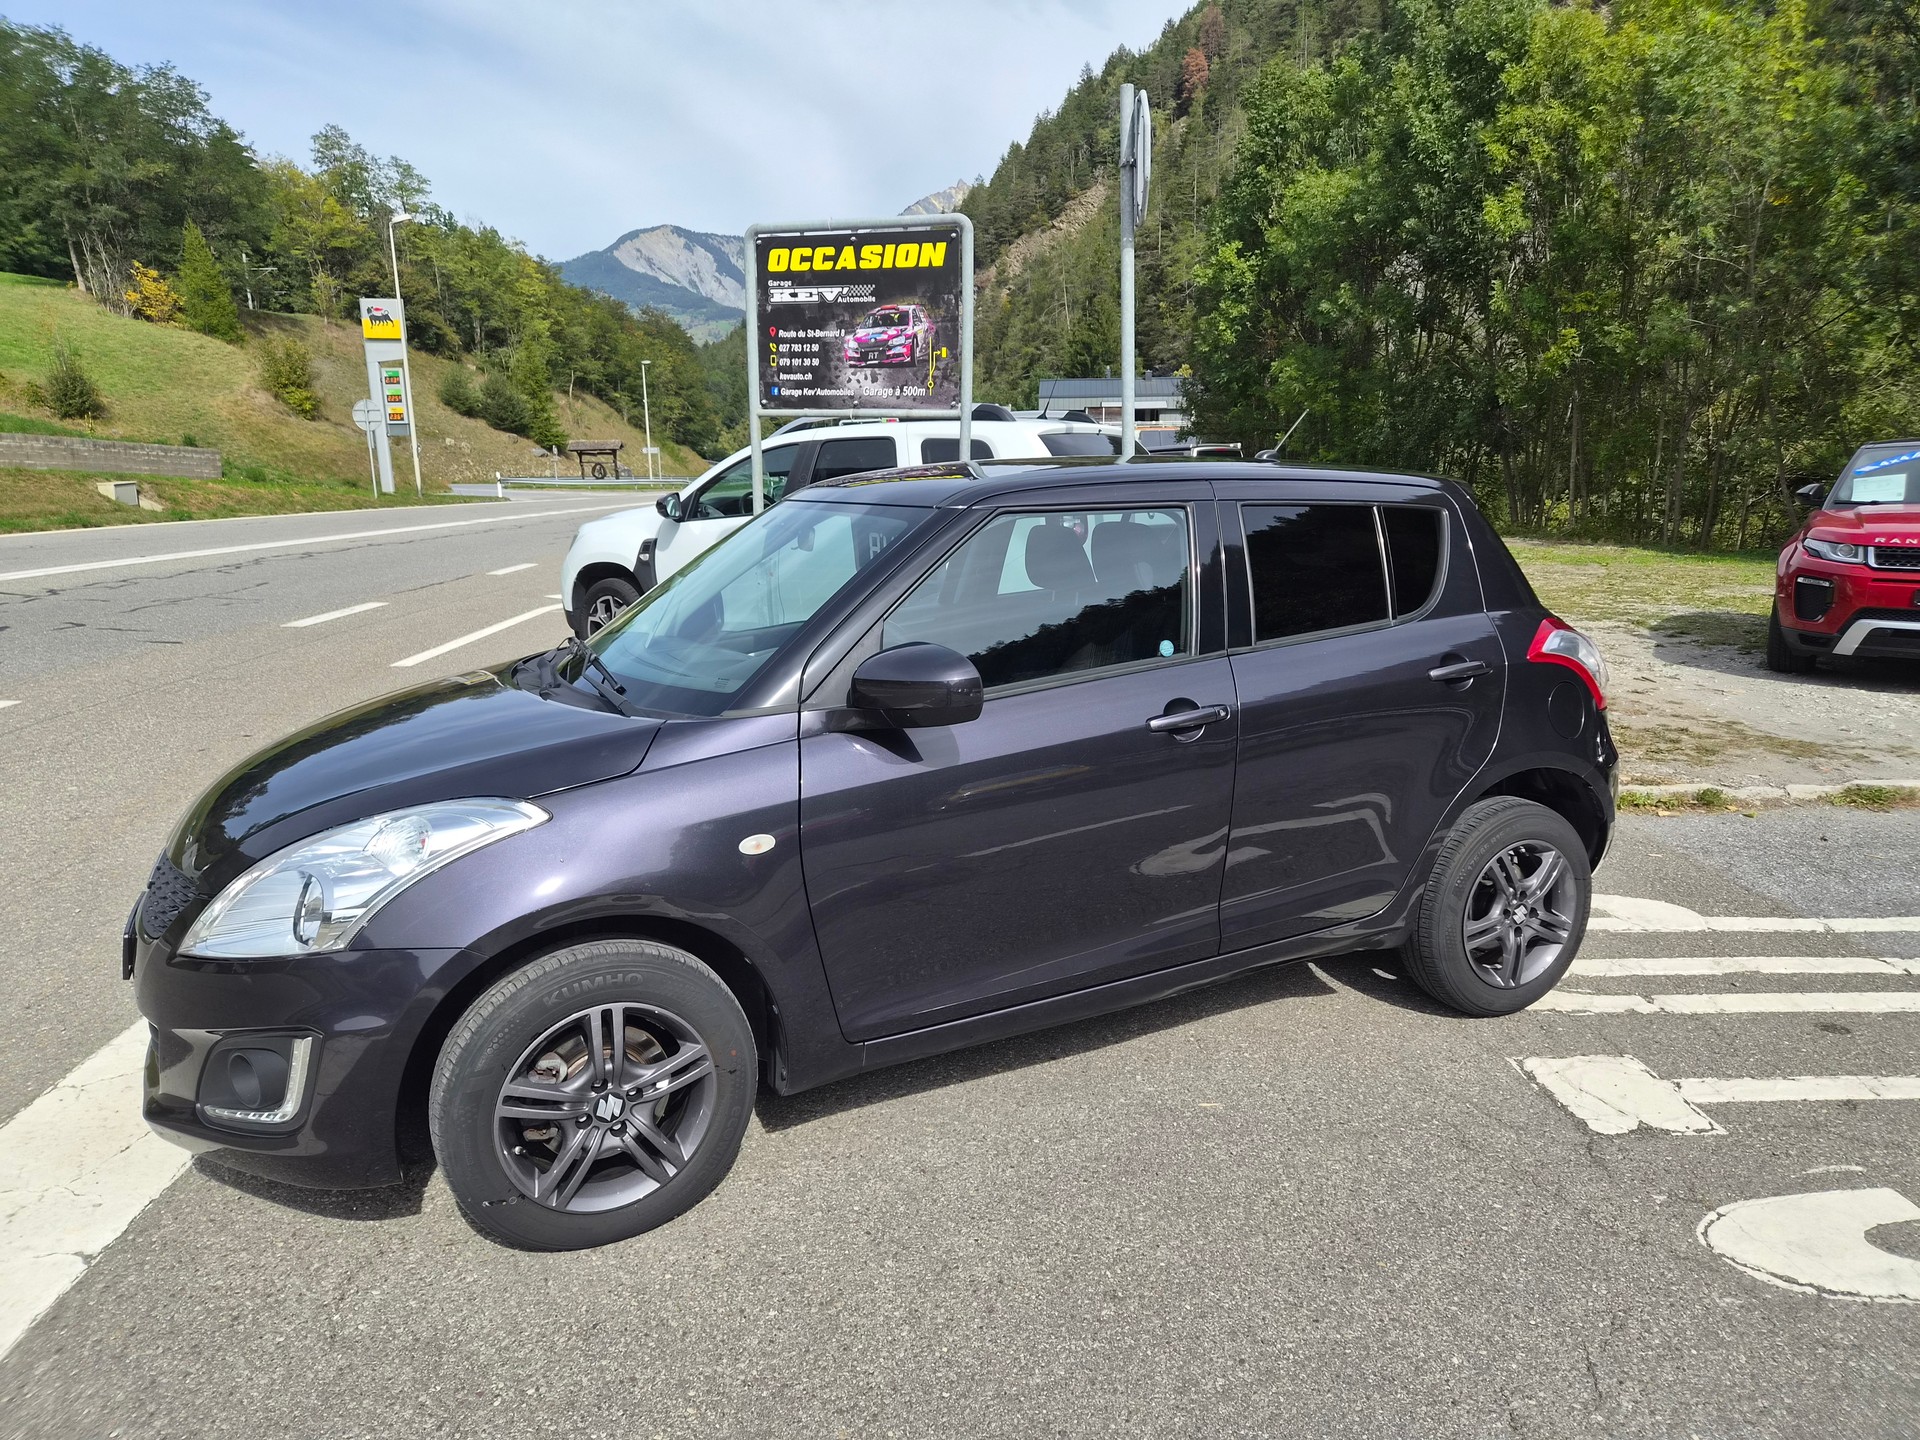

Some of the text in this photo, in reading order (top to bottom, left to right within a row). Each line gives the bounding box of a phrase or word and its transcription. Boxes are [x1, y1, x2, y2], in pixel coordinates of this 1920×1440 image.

[767, 242, 947, 272] OCCASION
[767, 279, 792, 288] Garage
[837, 295, 876, 303] Automobile
[778, 329, 797, 338] Route
[797, 329, 806, 338] du
[806, 328, 840, 338] St-Bernard
[778, 343, 820, 352] 027 783 12 50
[779, 357, 820, 366] 079 101 30 50
[779, 372, 813, 381] kevauto.ch
[780, 387, 803, 398] Garage
[863, 385, 926, 399] Garage à 500m
[543, 972, 644, 1006] KUMHO
